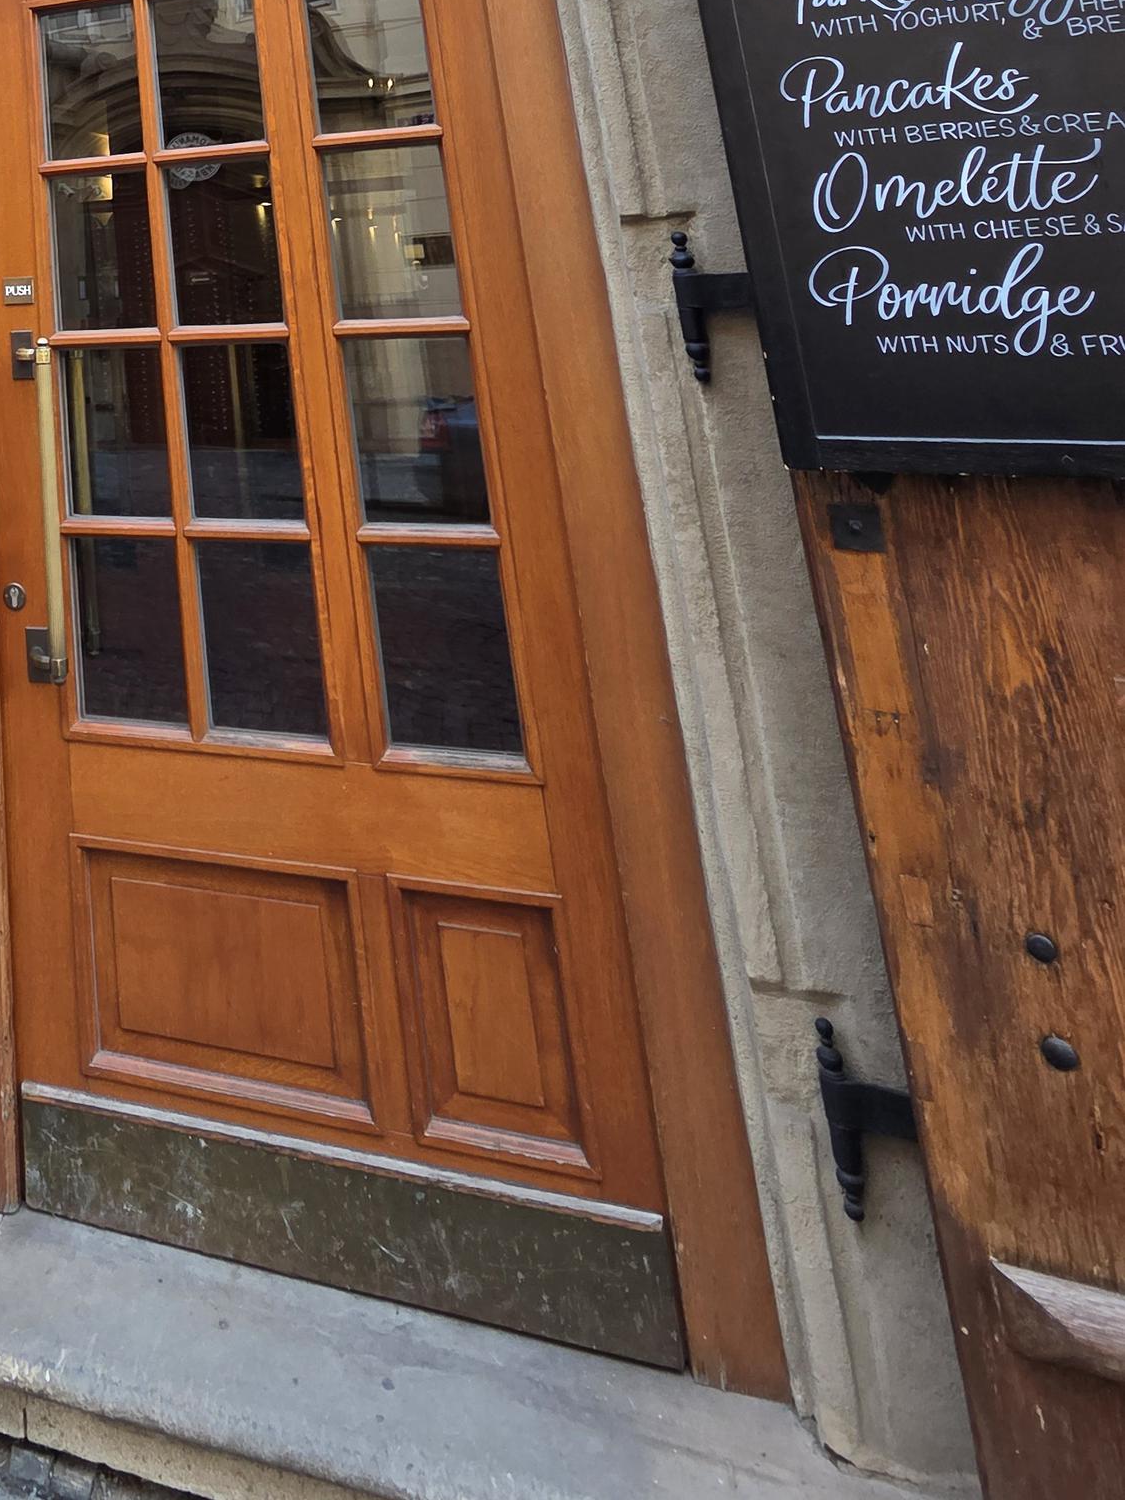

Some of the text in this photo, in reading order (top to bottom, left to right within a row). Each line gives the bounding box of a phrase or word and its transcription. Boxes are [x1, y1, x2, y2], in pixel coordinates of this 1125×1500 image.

[810, 13, 879, 39] WITH
[883, 1, 1006, 33] YOGHURT,
[1022, 17, 1044, 40] &
[779, 41, 1040, 129] Pancakes
[833, 126, 897, 148] WITH
[904, 117, 1017, 144] BERRIES
[813, 137, 1102, 233] Omelette
[905, 213, 1125, 243] WITH CHEESE & S
[5, 285, 32, 296] PUSH
[808, 242, 1096, 357] Porridge
[876, 335, 939, 354] WITH
[945, 334, 1010, 354] NUTS
[1050, 333, 1075, 357] &
